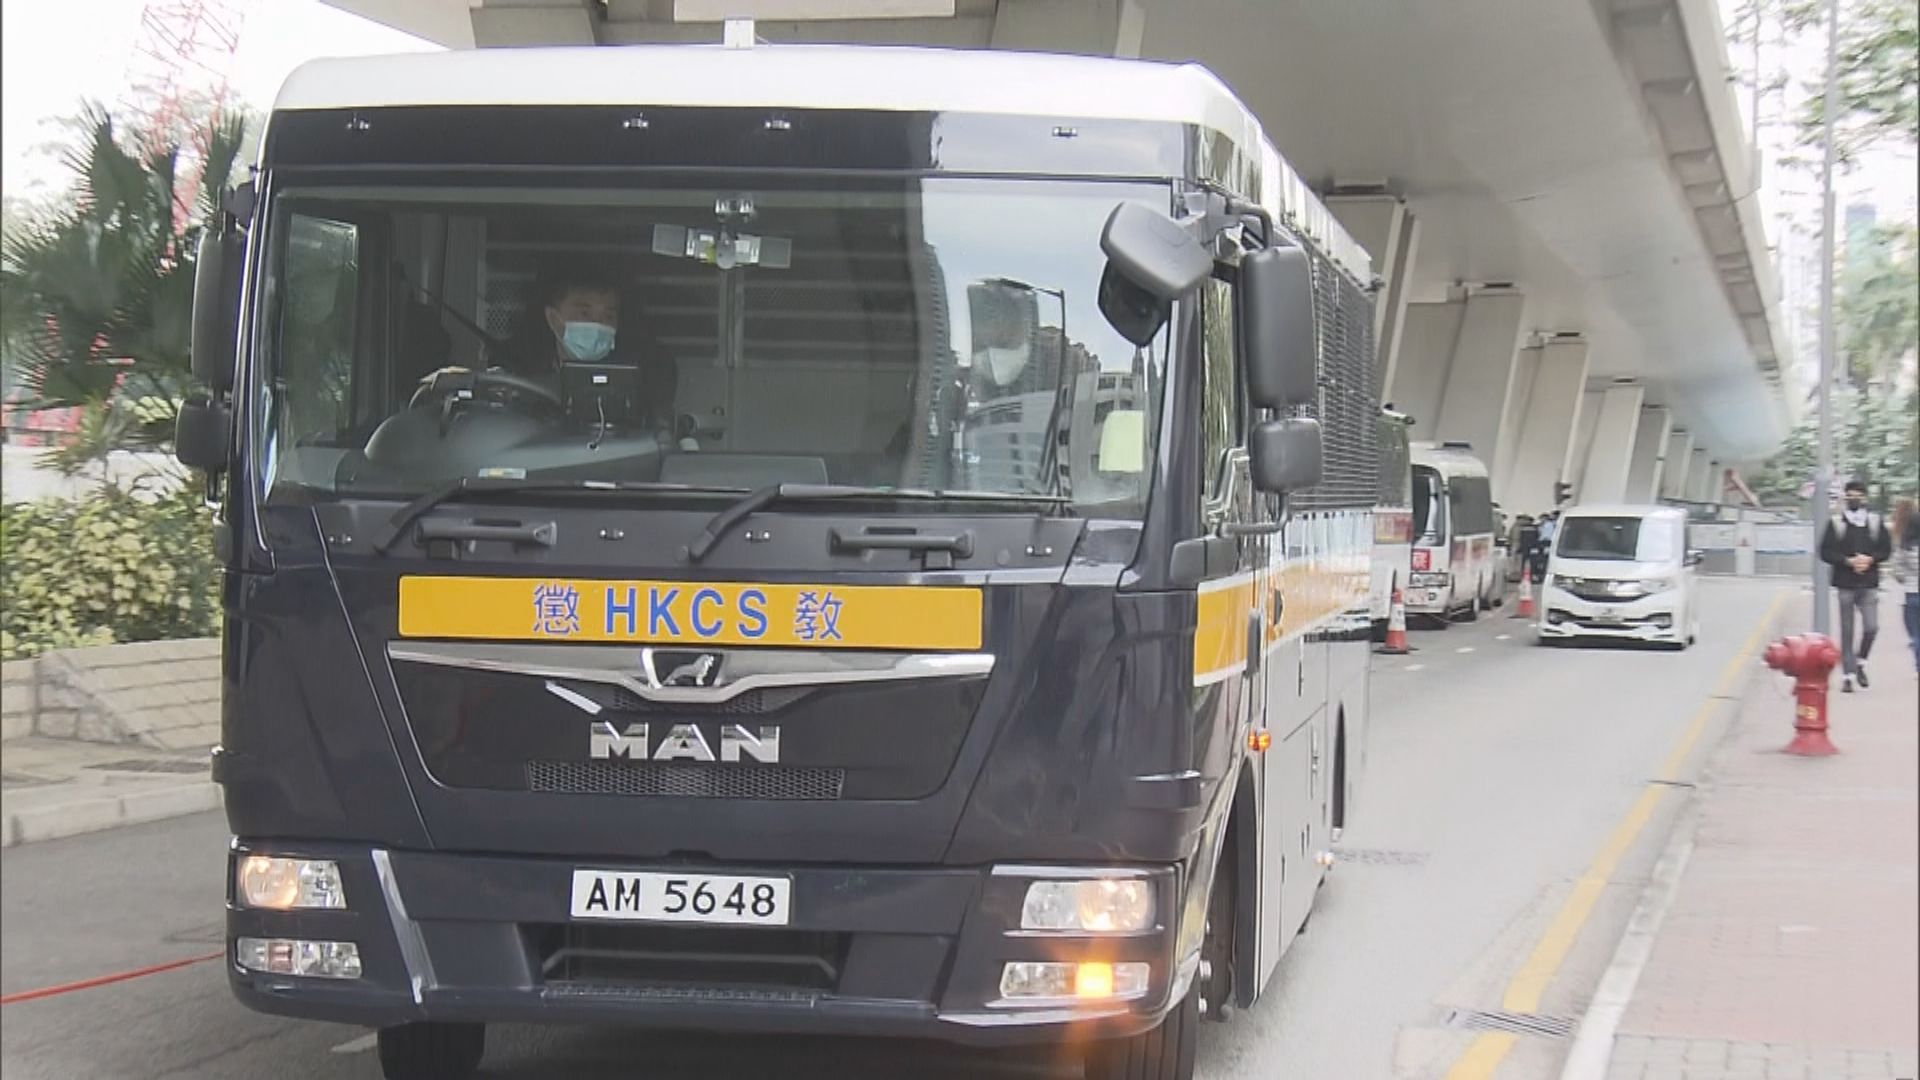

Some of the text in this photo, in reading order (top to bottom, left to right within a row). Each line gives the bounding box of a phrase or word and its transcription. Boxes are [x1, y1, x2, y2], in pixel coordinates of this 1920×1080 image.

[533, 583, 580, 634] 懲
[606, 587, 768, 637] HKCS
[590, 722, 780, 764] MAN
[586, 878, 776, 917] AM 5648
